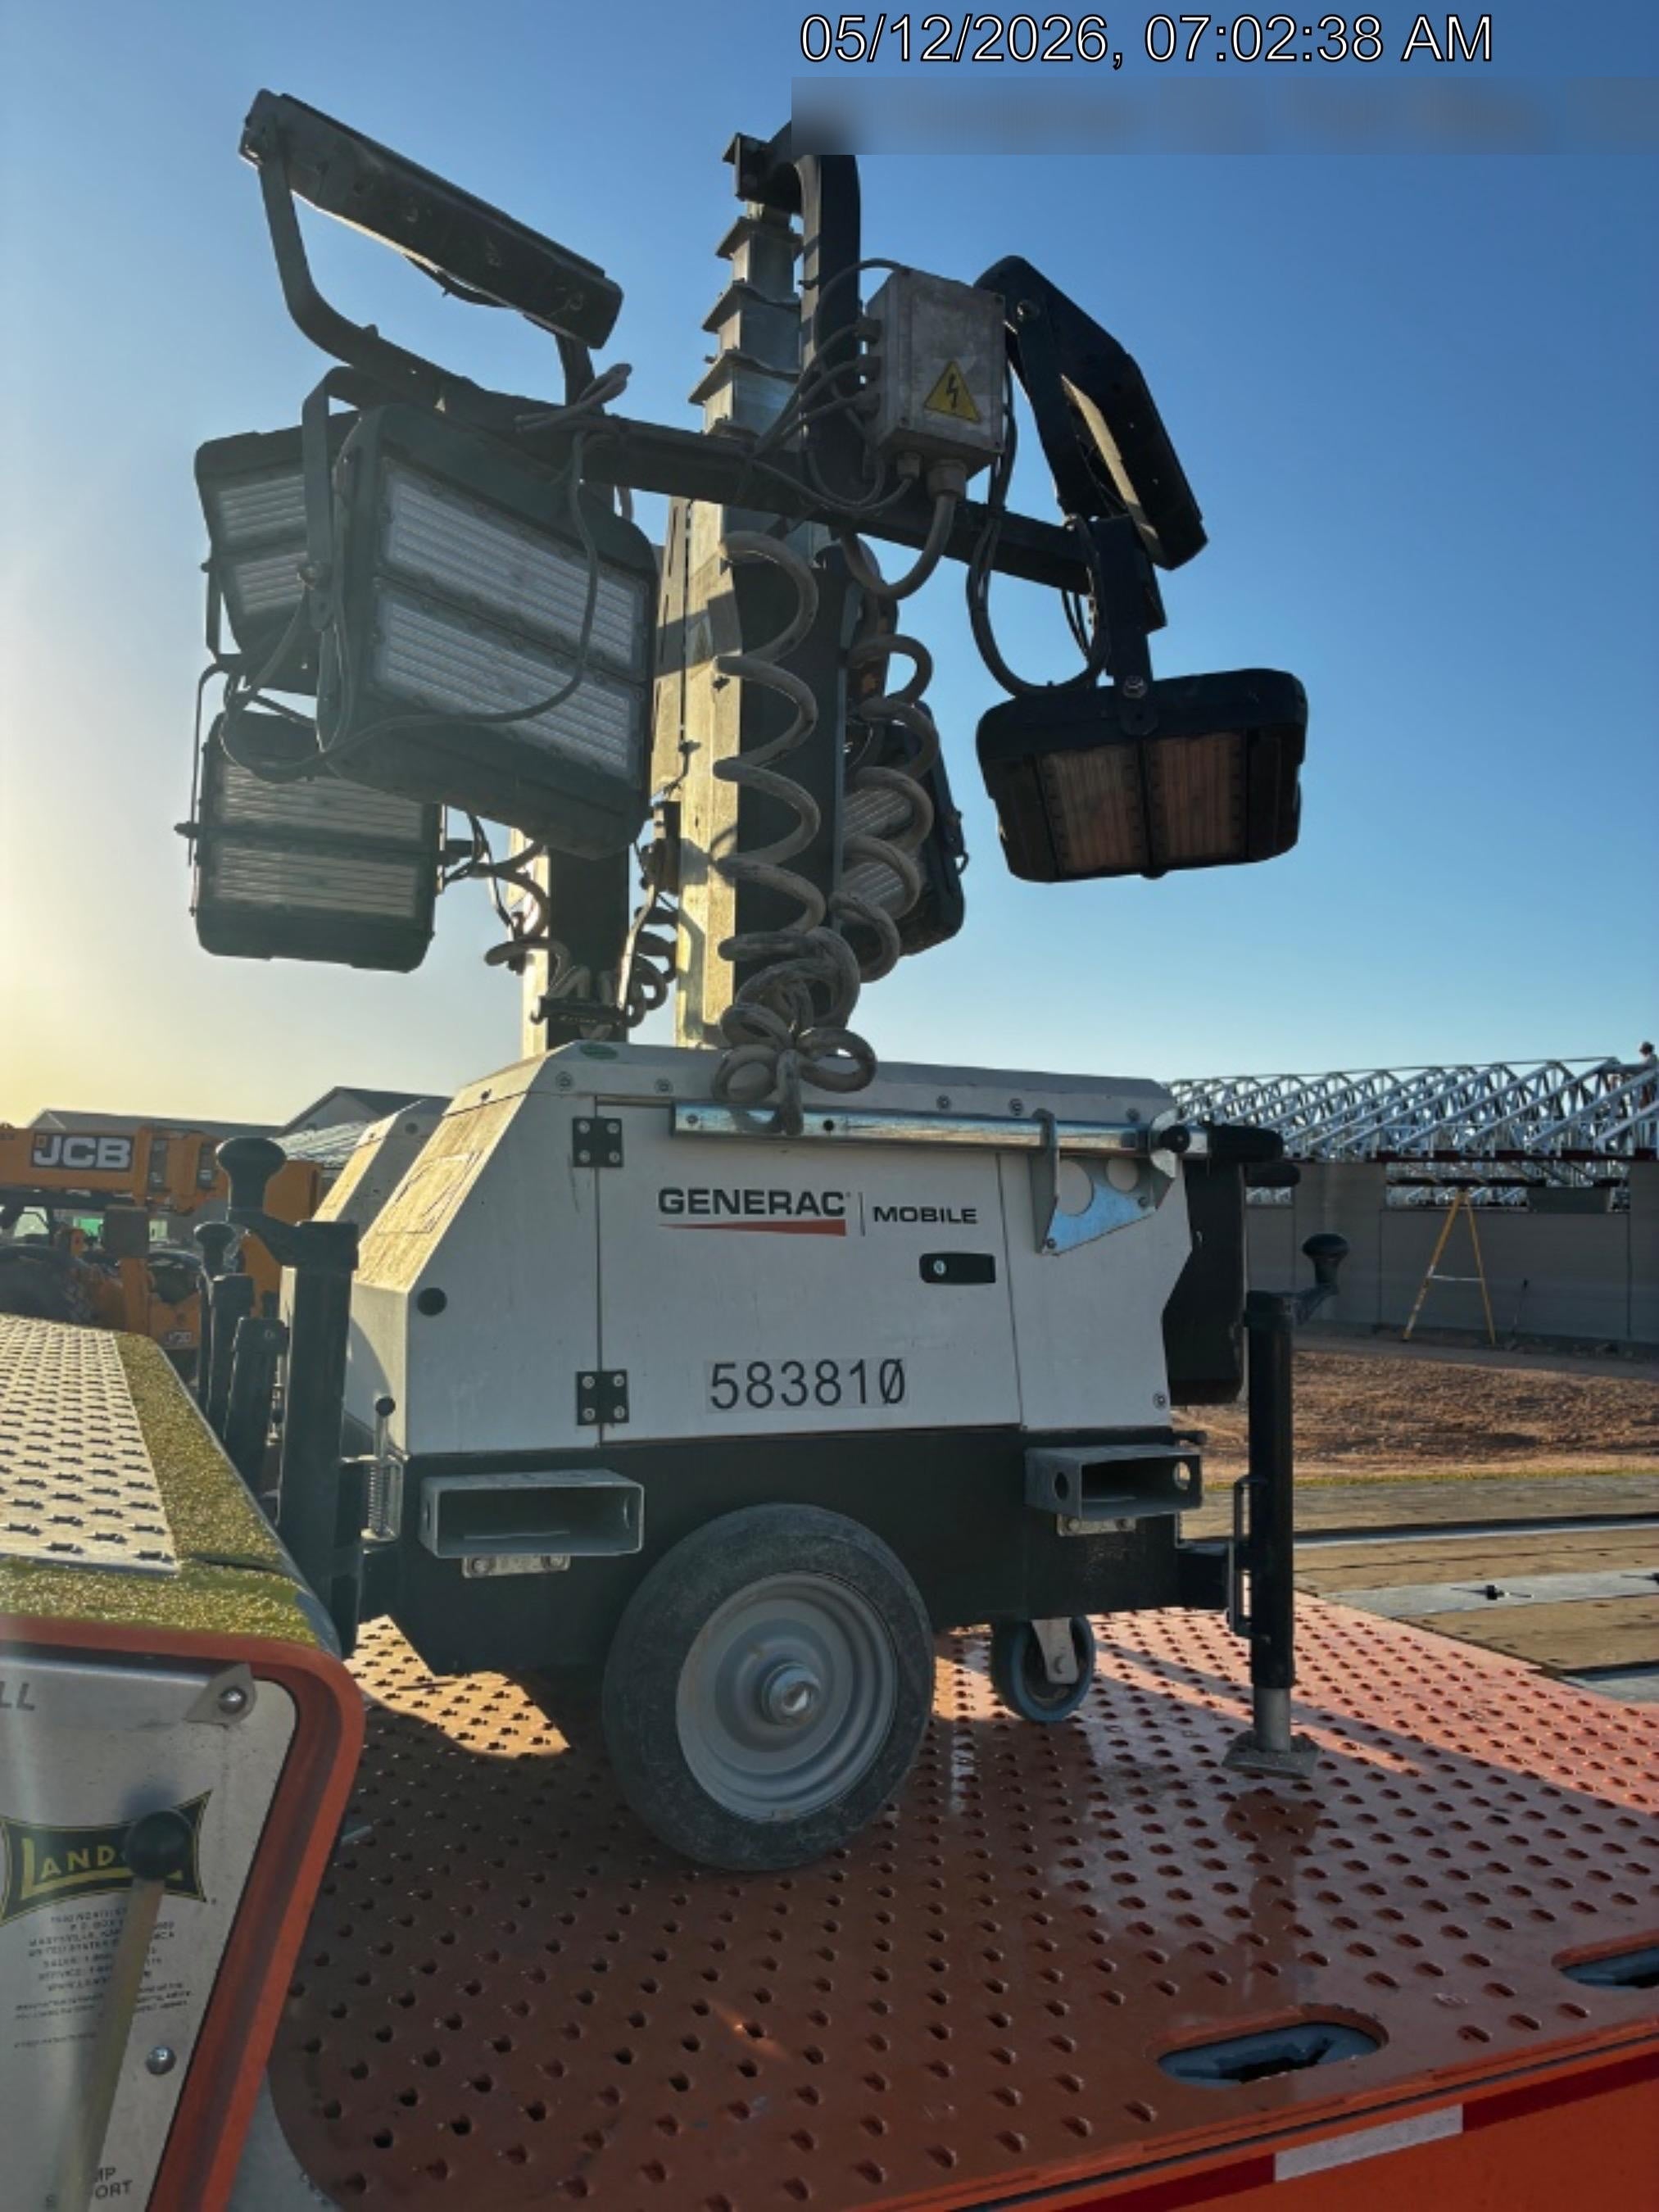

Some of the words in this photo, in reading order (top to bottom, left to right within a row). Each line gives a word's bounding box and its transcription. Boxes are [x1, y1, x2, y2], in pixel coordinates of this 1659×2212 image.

[34, 1136, 131, 1168] JCB
[658, 1188, 846, 1217] GENERAC
[873, 1205, 977, 1225] MOBILE
[709, 1358, 905, 1410] 583810
[21, 1836, 132, 1900] LAND
